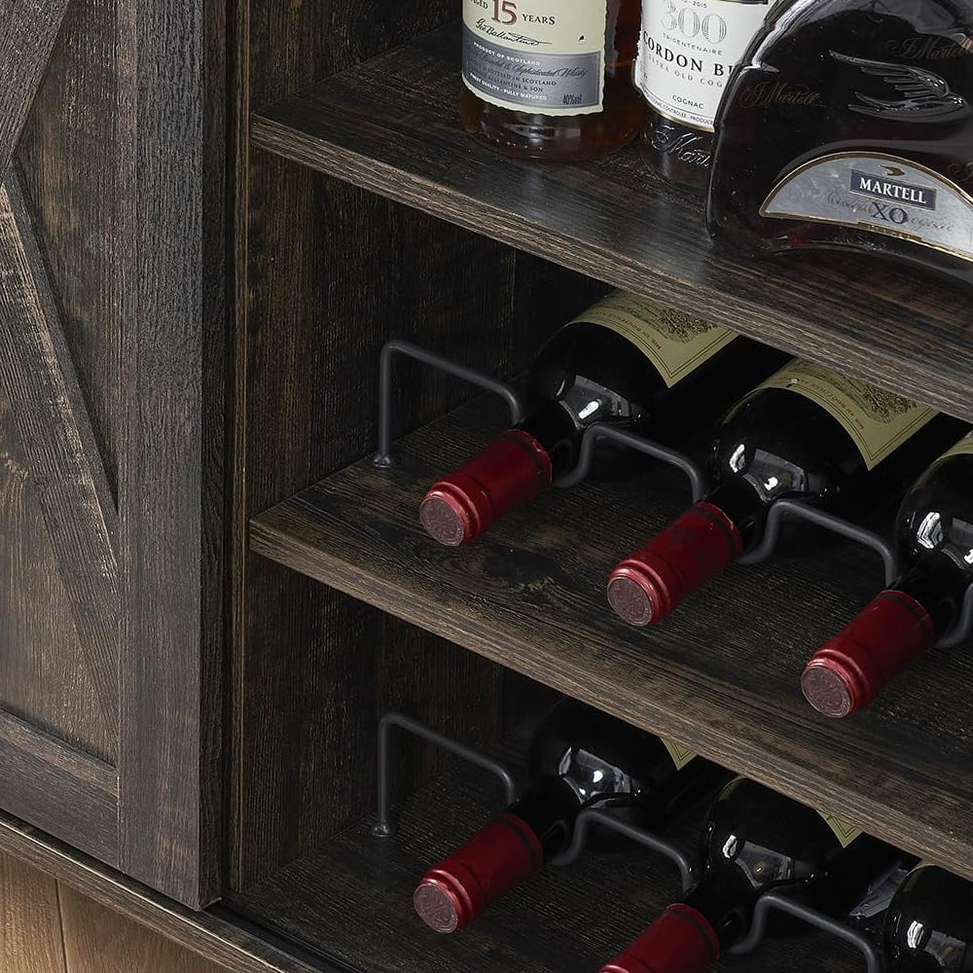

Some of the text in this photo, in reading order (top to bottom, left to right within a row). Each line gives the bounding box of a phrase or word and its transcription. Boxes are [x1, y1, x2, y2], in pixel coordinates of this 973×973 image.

[522, 13, 556, 26] YEARS
[473, 41, 495, 55] PRODUCT
[507, 56, 541, 66] SCOTLAND
[643, 30, 703, 72] CORDON
[522, 78, 557, 86] SCOTLAND
[674, 69, 693, 81] OLD
[672, 94, 705, 110] COGNAC
[859, 177, 927, 204] MARTELL
[872, 201, 908, 225] XO
